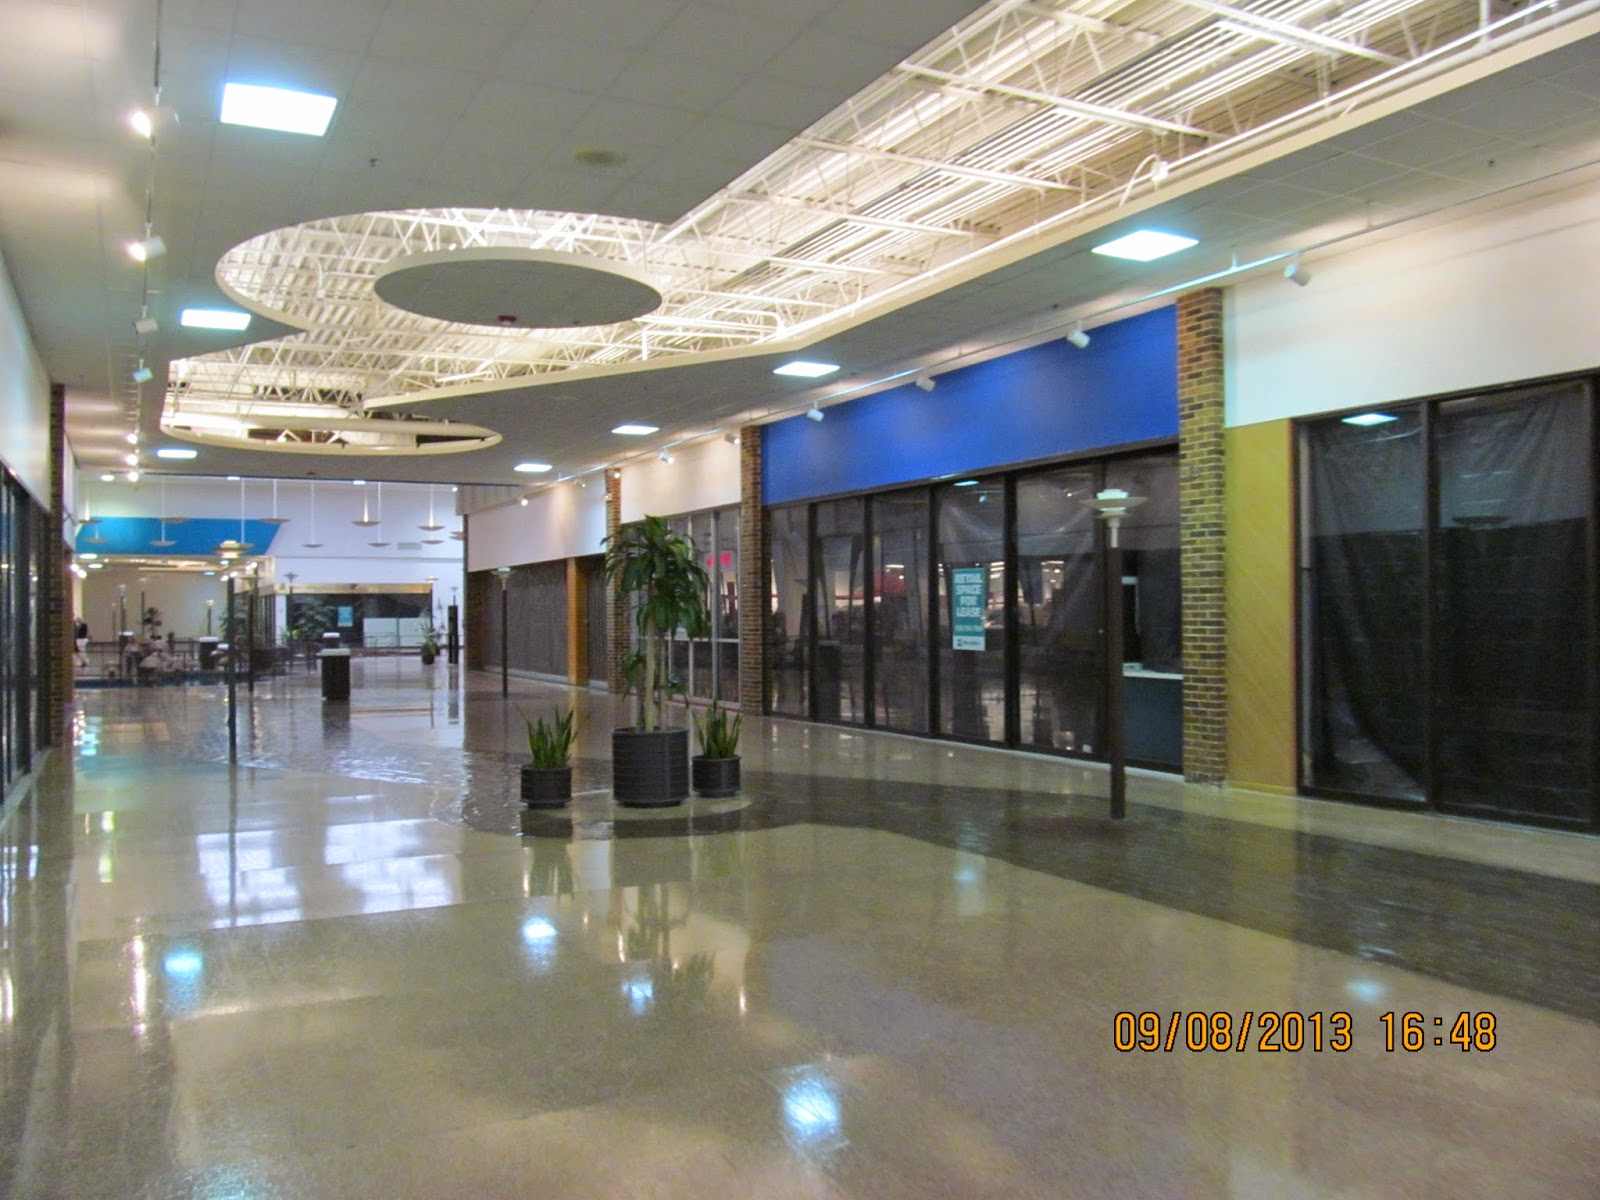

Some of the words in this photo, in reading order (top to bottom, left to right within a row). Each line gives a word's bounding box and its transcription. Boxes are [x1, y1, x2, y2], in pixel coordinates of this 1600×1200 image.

[955, 573, 983, 584] RETAIL
[956, 585, 981, 595] SPACE
[960, 596, 977, 606] FOR
[956, 607, 981, 617] LEASE
